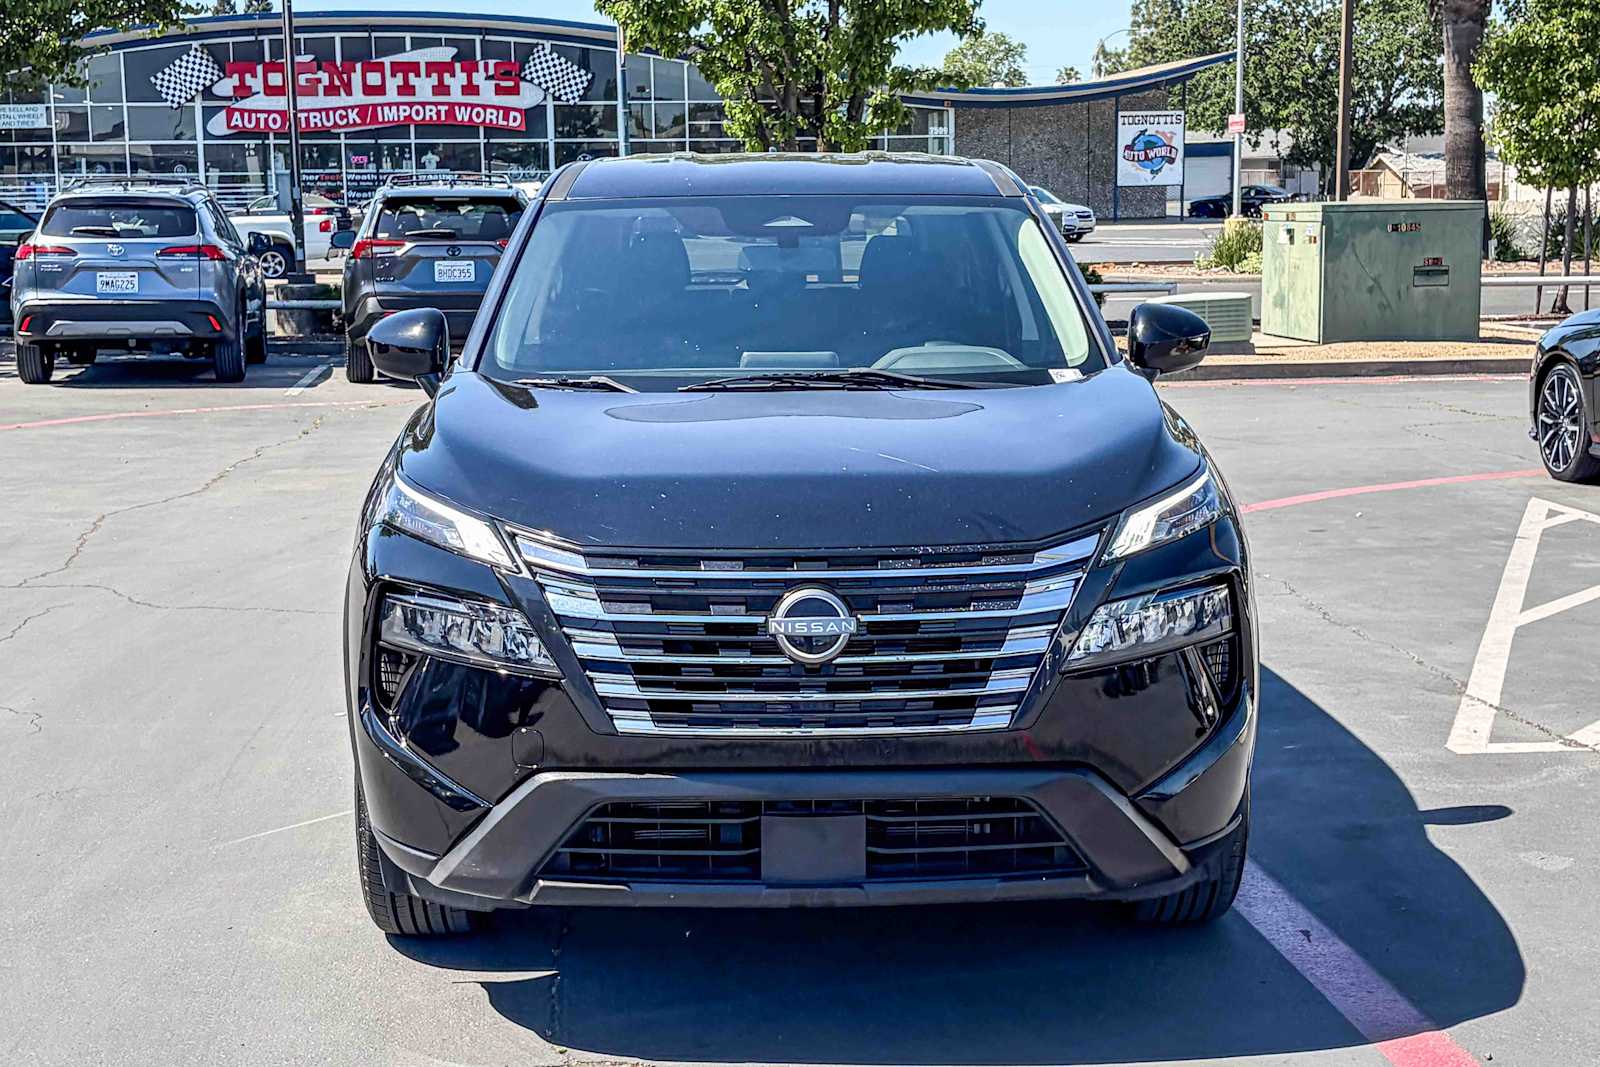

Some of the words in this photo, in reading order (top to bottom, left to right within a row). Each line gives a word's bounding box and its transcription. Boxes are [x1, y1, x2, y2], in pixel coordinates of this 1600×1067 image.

[225, 61, 520, 97] TOGNOTTI'S
[230, 111, 282, 130] AUTO
[297, 107, 362, 129] TRUCK
[377, 105, 449, 122] IMPORT
[454, 105, 522, 127] WORLD
[1120, 113, 1183, 126] TOGNOTTI'S
[100, 279, 136, 290] 9MAG225
[771, 620, 855, 634] NISSAN
